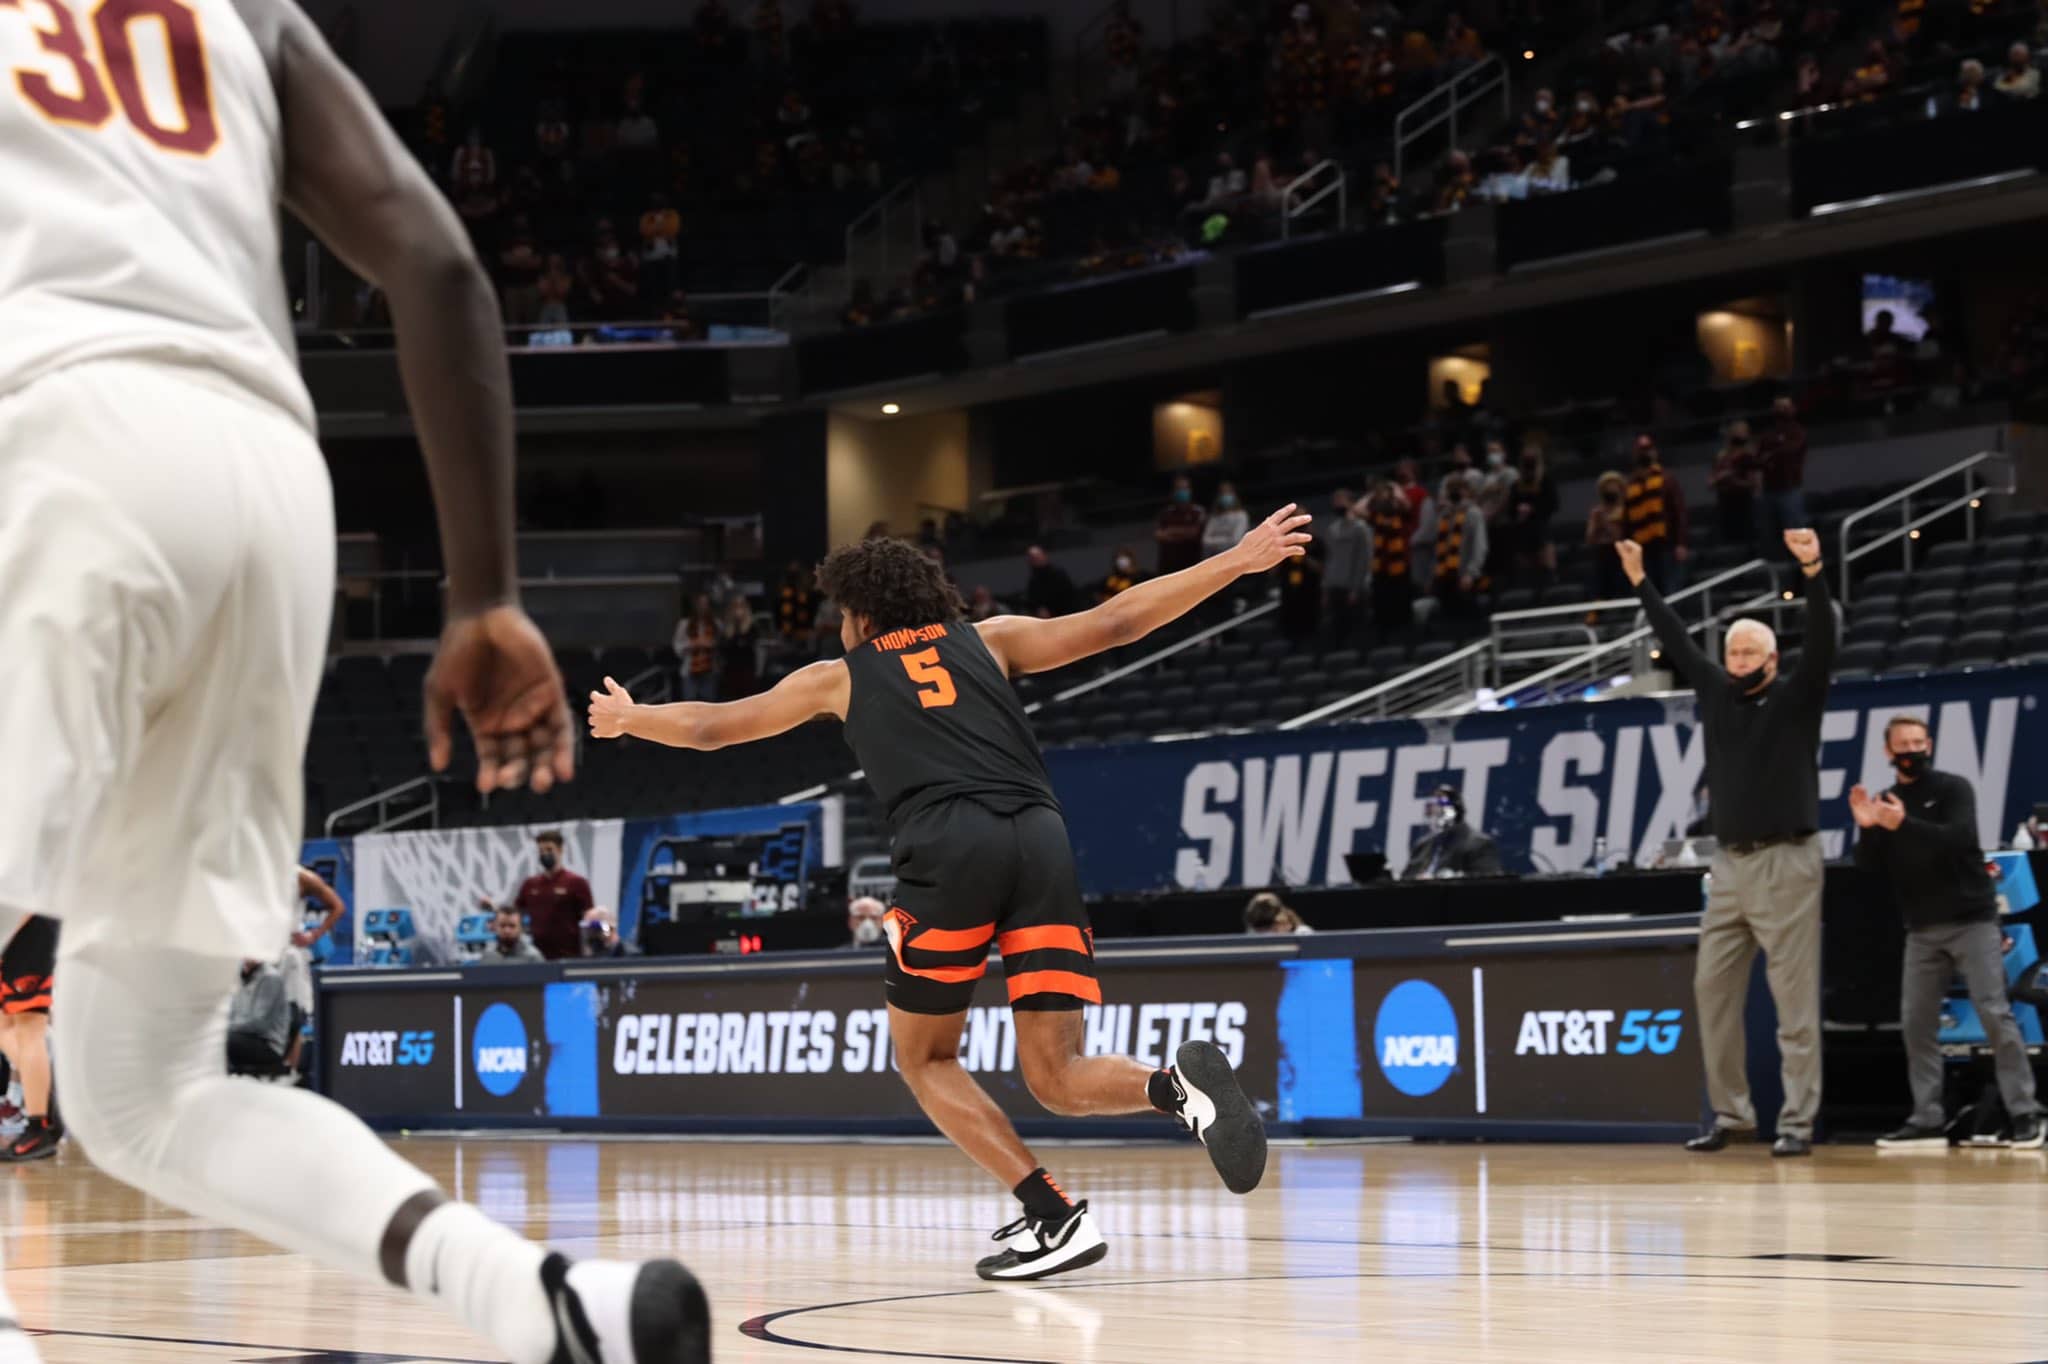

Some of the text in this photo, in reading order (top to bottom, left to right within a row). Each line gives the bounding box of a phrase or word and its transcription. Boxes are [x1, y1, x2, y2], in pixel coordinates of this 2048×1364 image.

[0, 0, 221, 158] 30
[870, 623, 948, 652] THOMPSON
[899, 646, 958, 709] 5
[1175, 738, 1510, 890] SWEET
[340, 1030, 436, 1066] AT&T 5G
[613, 1010, 836, 1075] CELEBRATES
[1383, 1035, 1457, 1067] NCAA
[1515, 1009, 1683, 1056] AT&T 5G
[477, 1047, 528, 1073] NCAA
